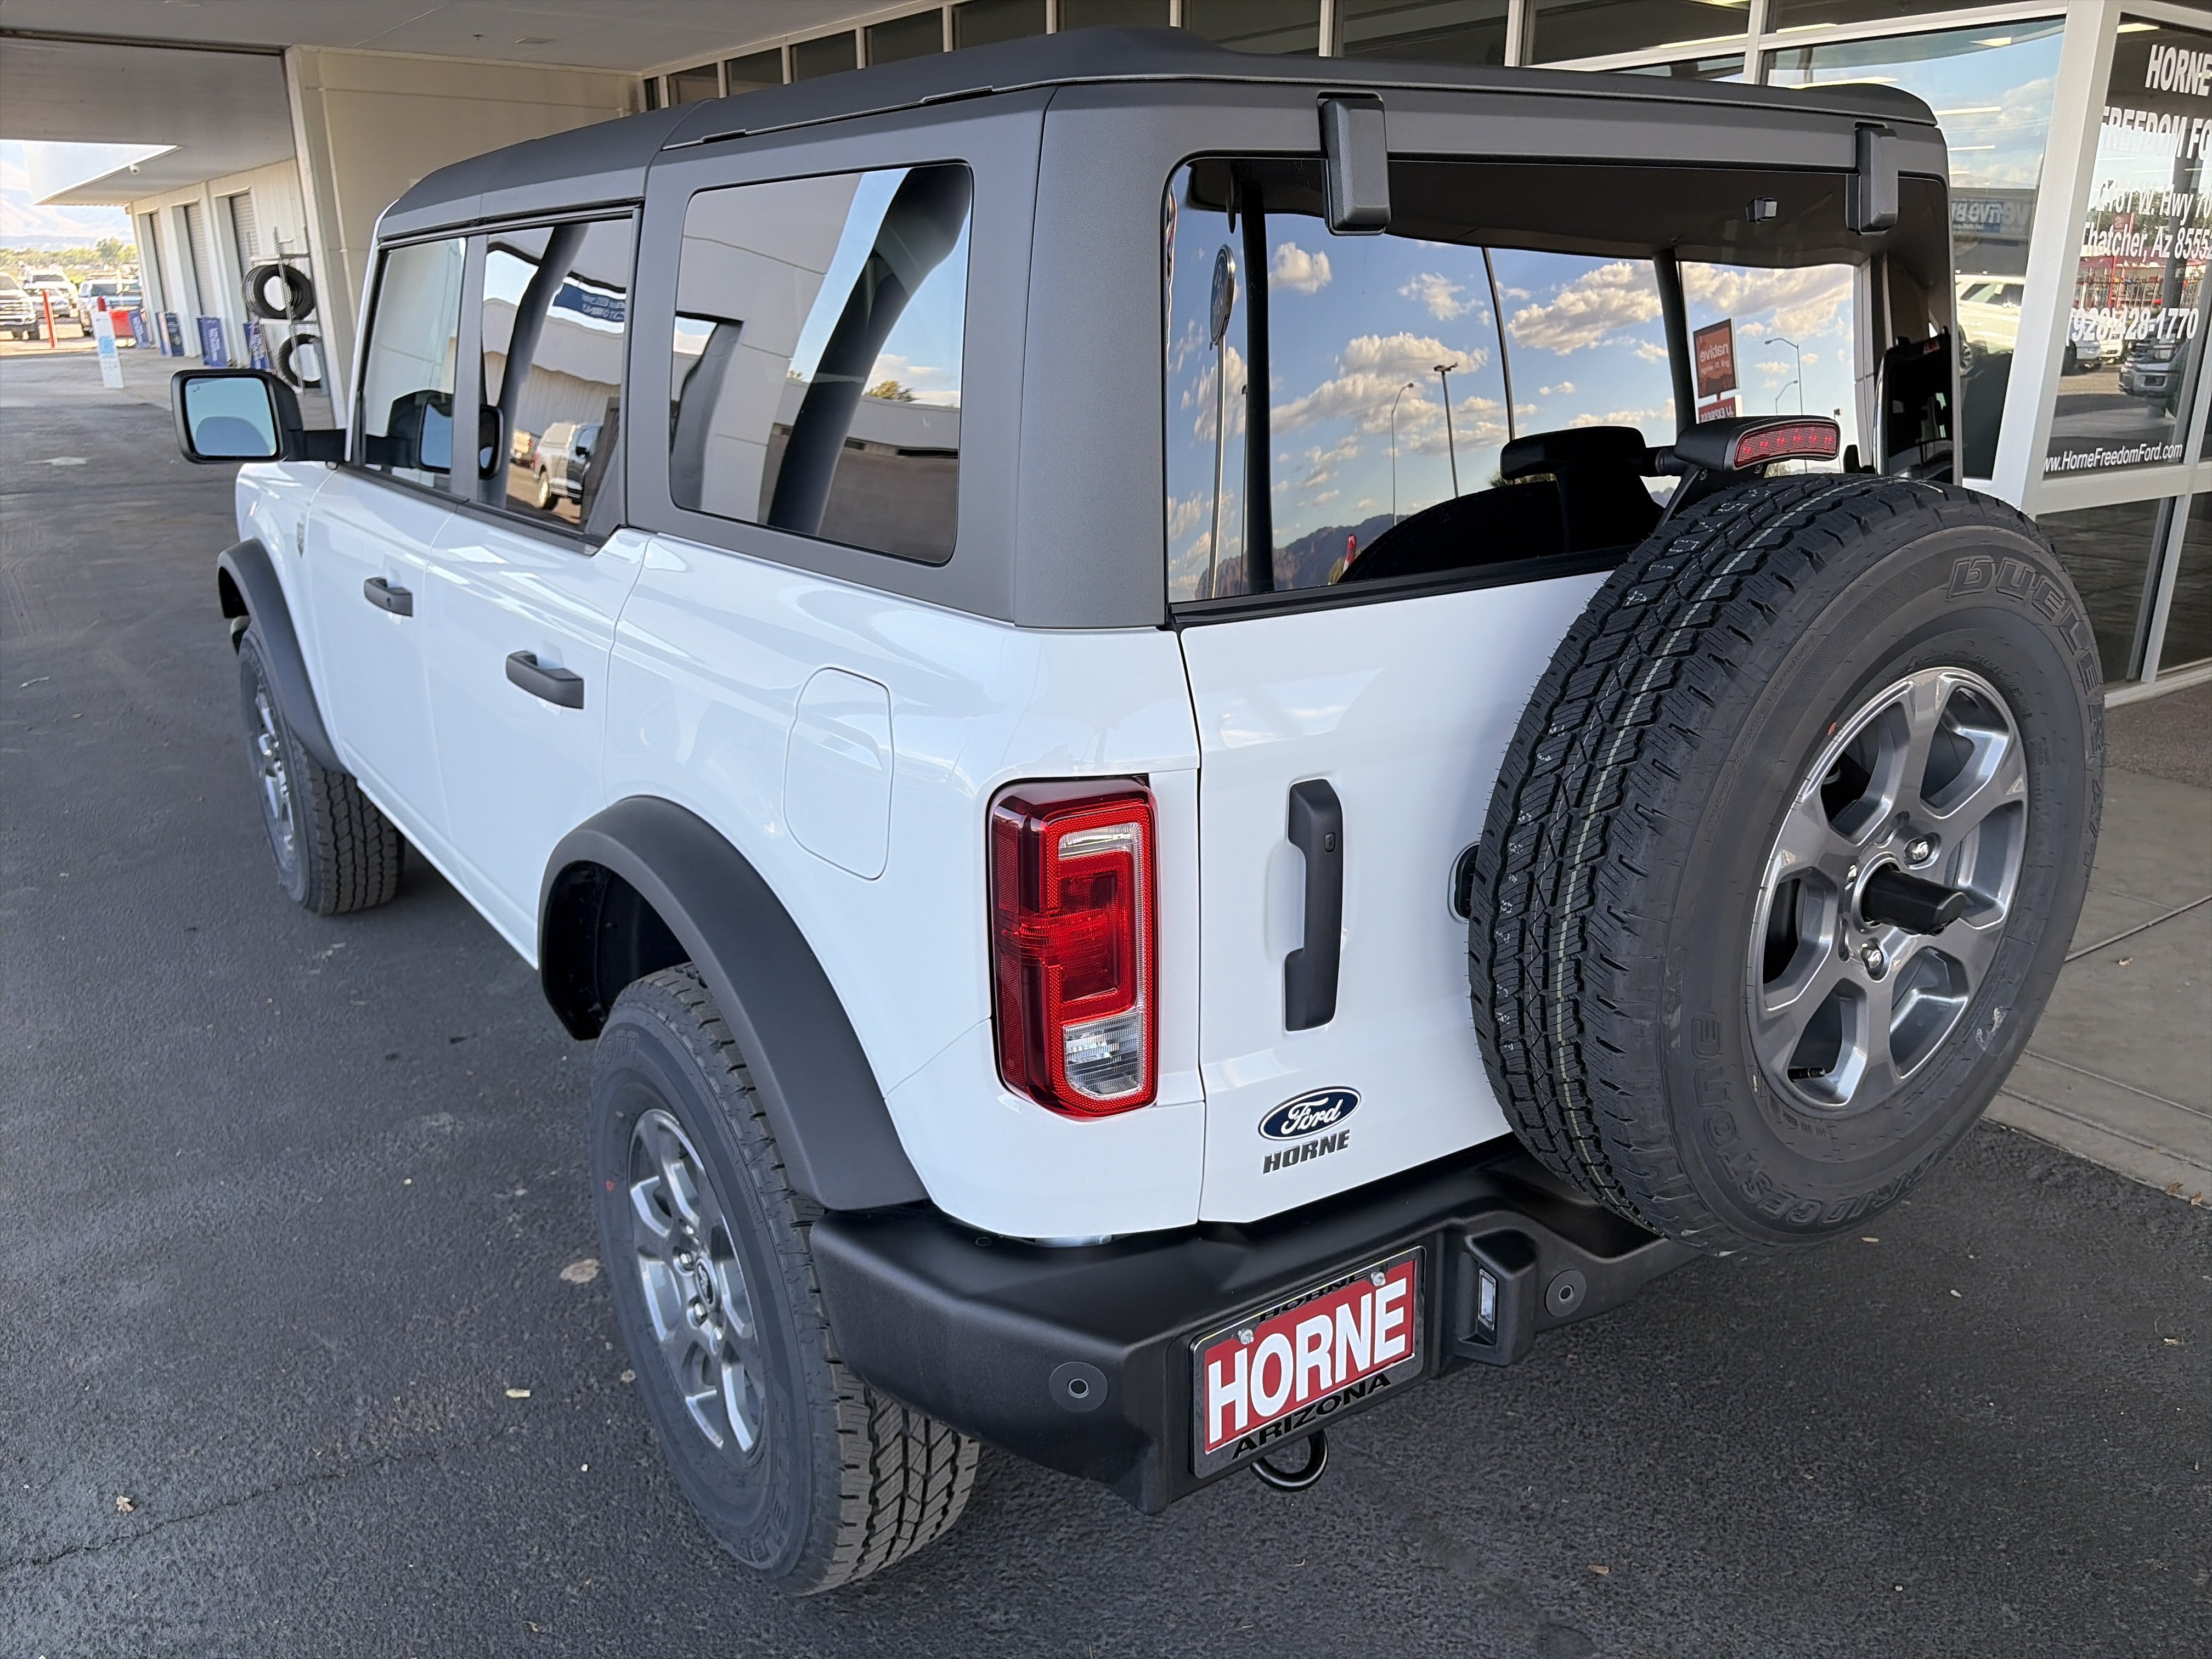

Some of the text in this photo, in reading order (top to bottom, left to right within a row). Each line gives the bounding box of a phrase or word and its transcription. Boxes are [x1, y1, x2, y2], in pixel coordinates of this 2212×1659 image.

[2145, 43, 2212, 97] HORNE
[2159, 184, 2194, 226] Hwy
[2079, 222, 2148, 263] Thatcher,
[2150, 226, 2173, 258] Az
[1280, 1097, 1344, 1135] Ford
[1262, 1128, 1350, 1174] HORNE
[1207, 1278, 1407, 1445] HORNE
[1231, 1372, 1392, 1460] ARIZONA
